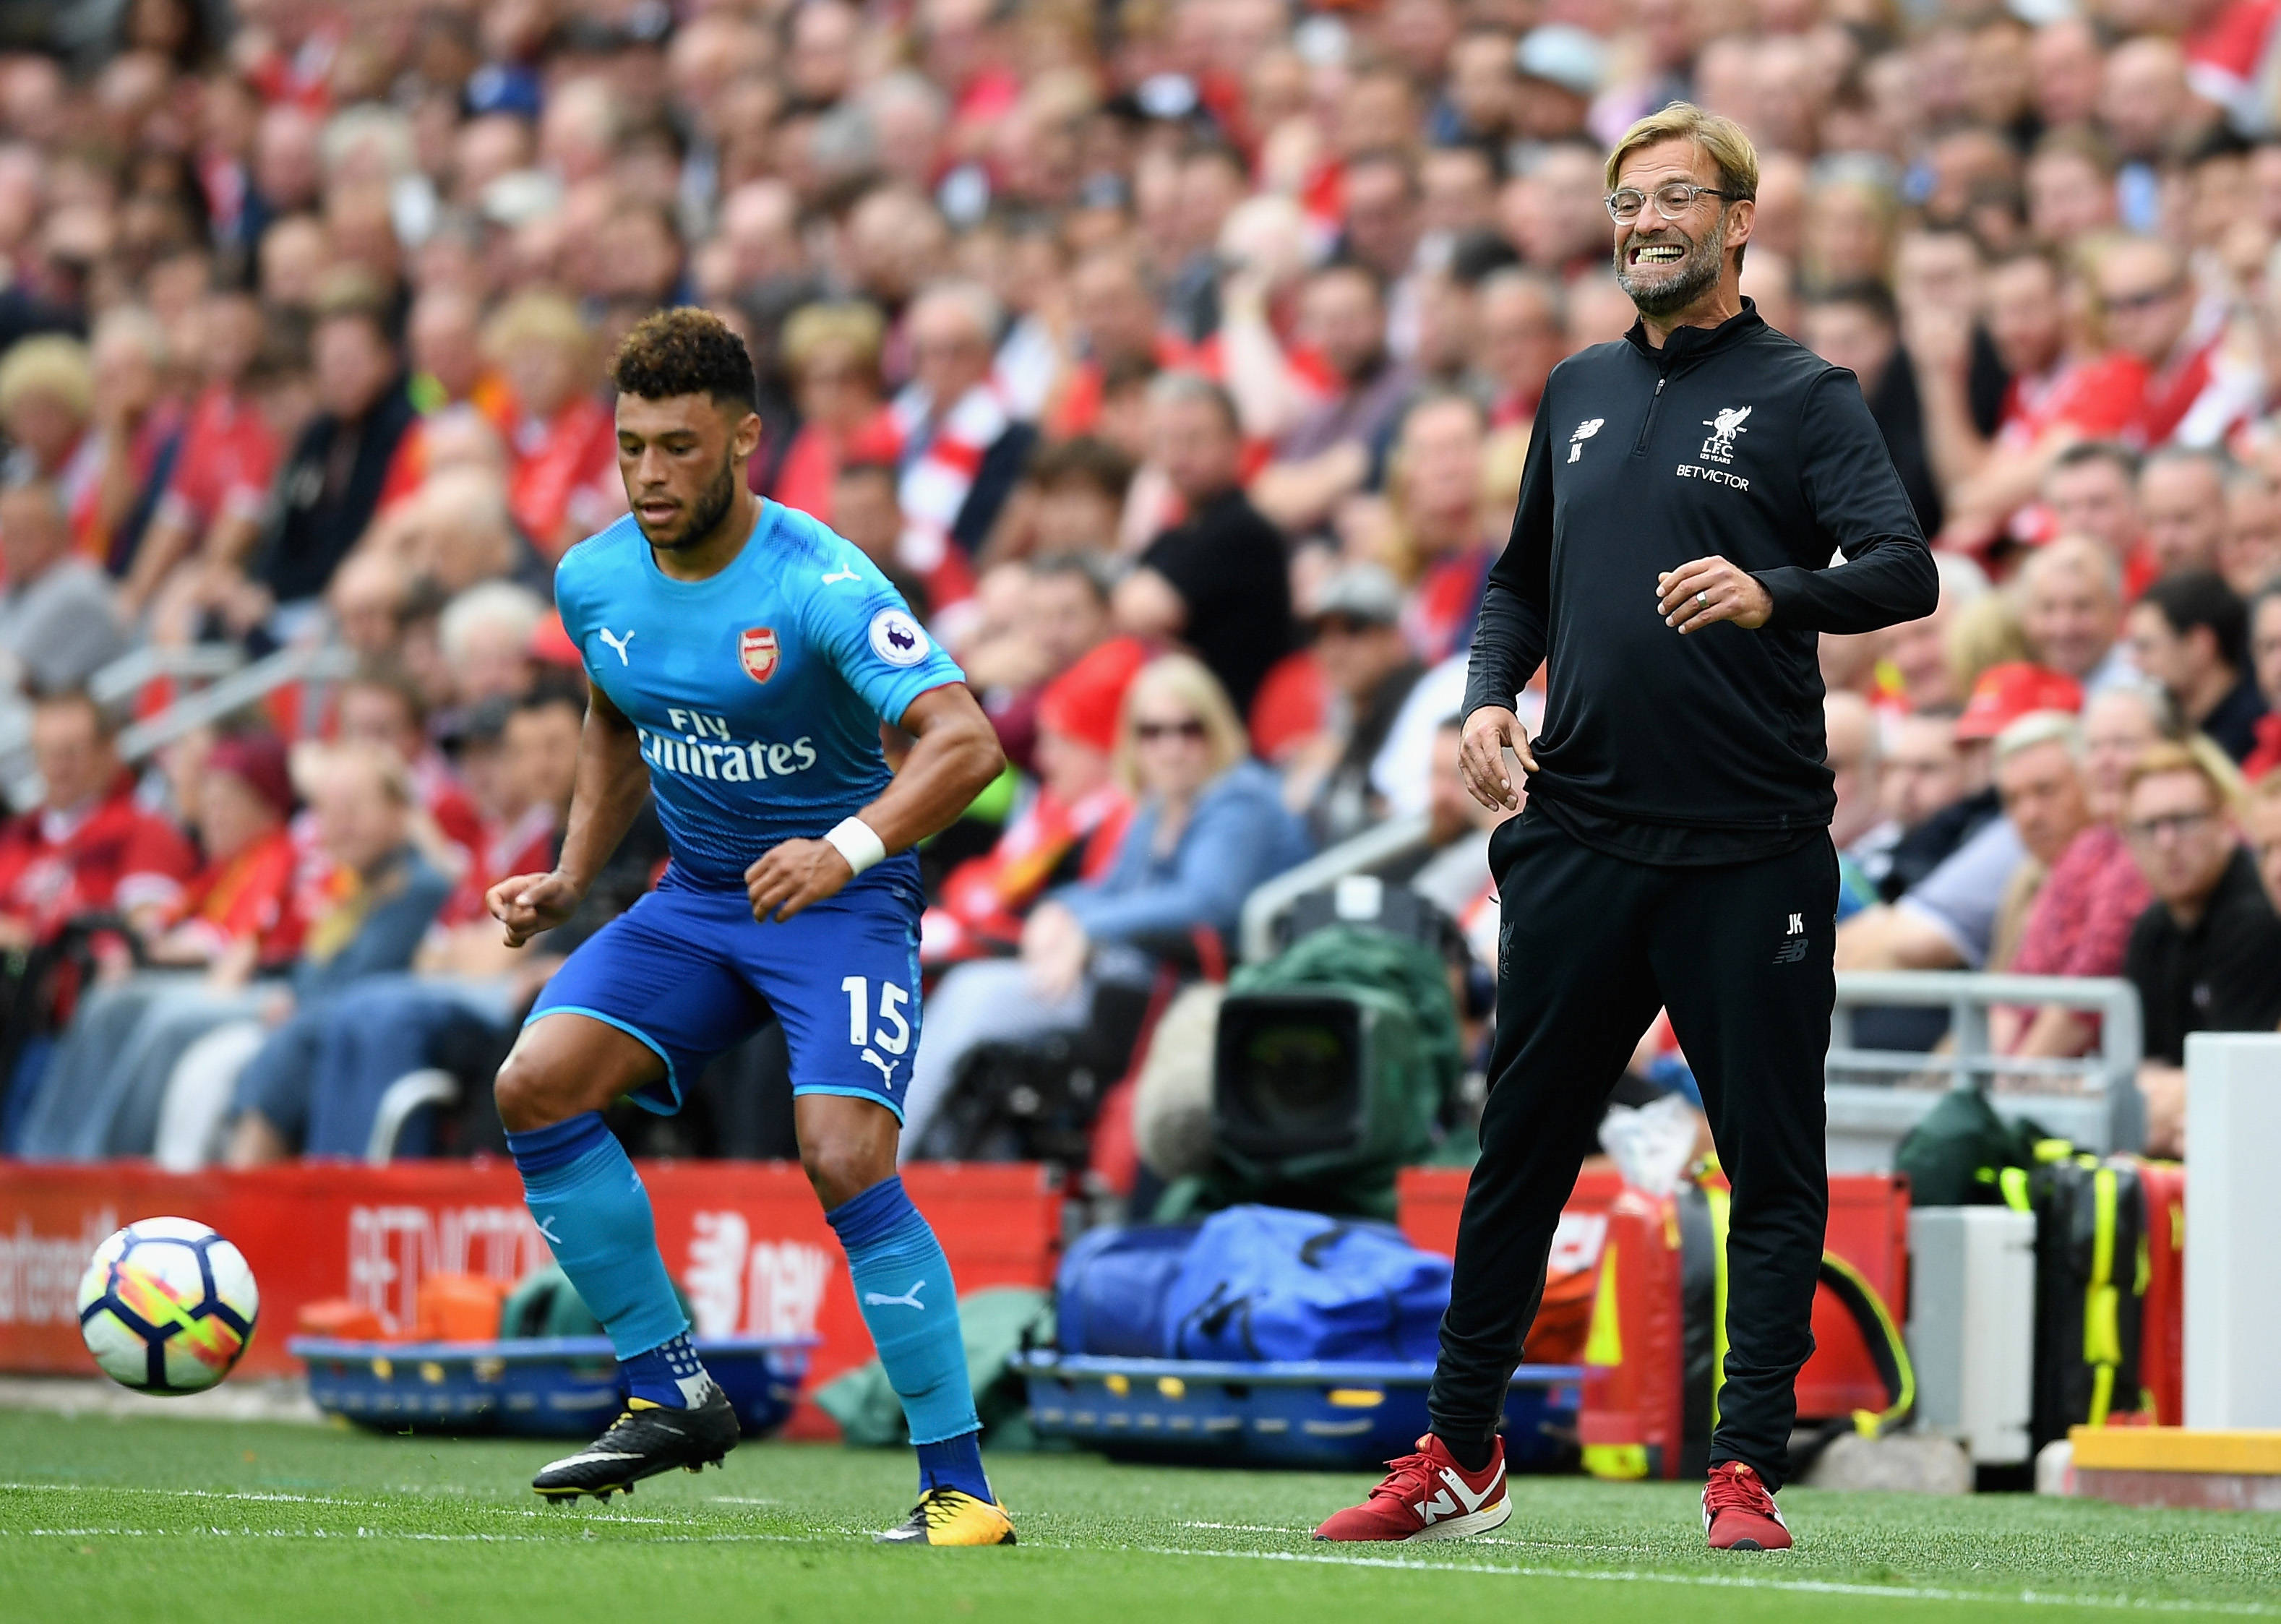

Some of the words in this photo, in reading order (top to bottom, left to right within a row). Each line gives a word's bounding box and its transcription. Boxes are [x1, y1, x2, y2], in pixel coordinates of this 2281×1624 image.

[1567, 442, 1583, 464] JK
[1710, 454, 1731, 465] YEARS
[1676, 464, 1750, 491] BETVICTOR
[667, 708, 731, 742] Fly
[1787, 913, 1803, 935] JK
[841, 975, 910, 1055] 15
